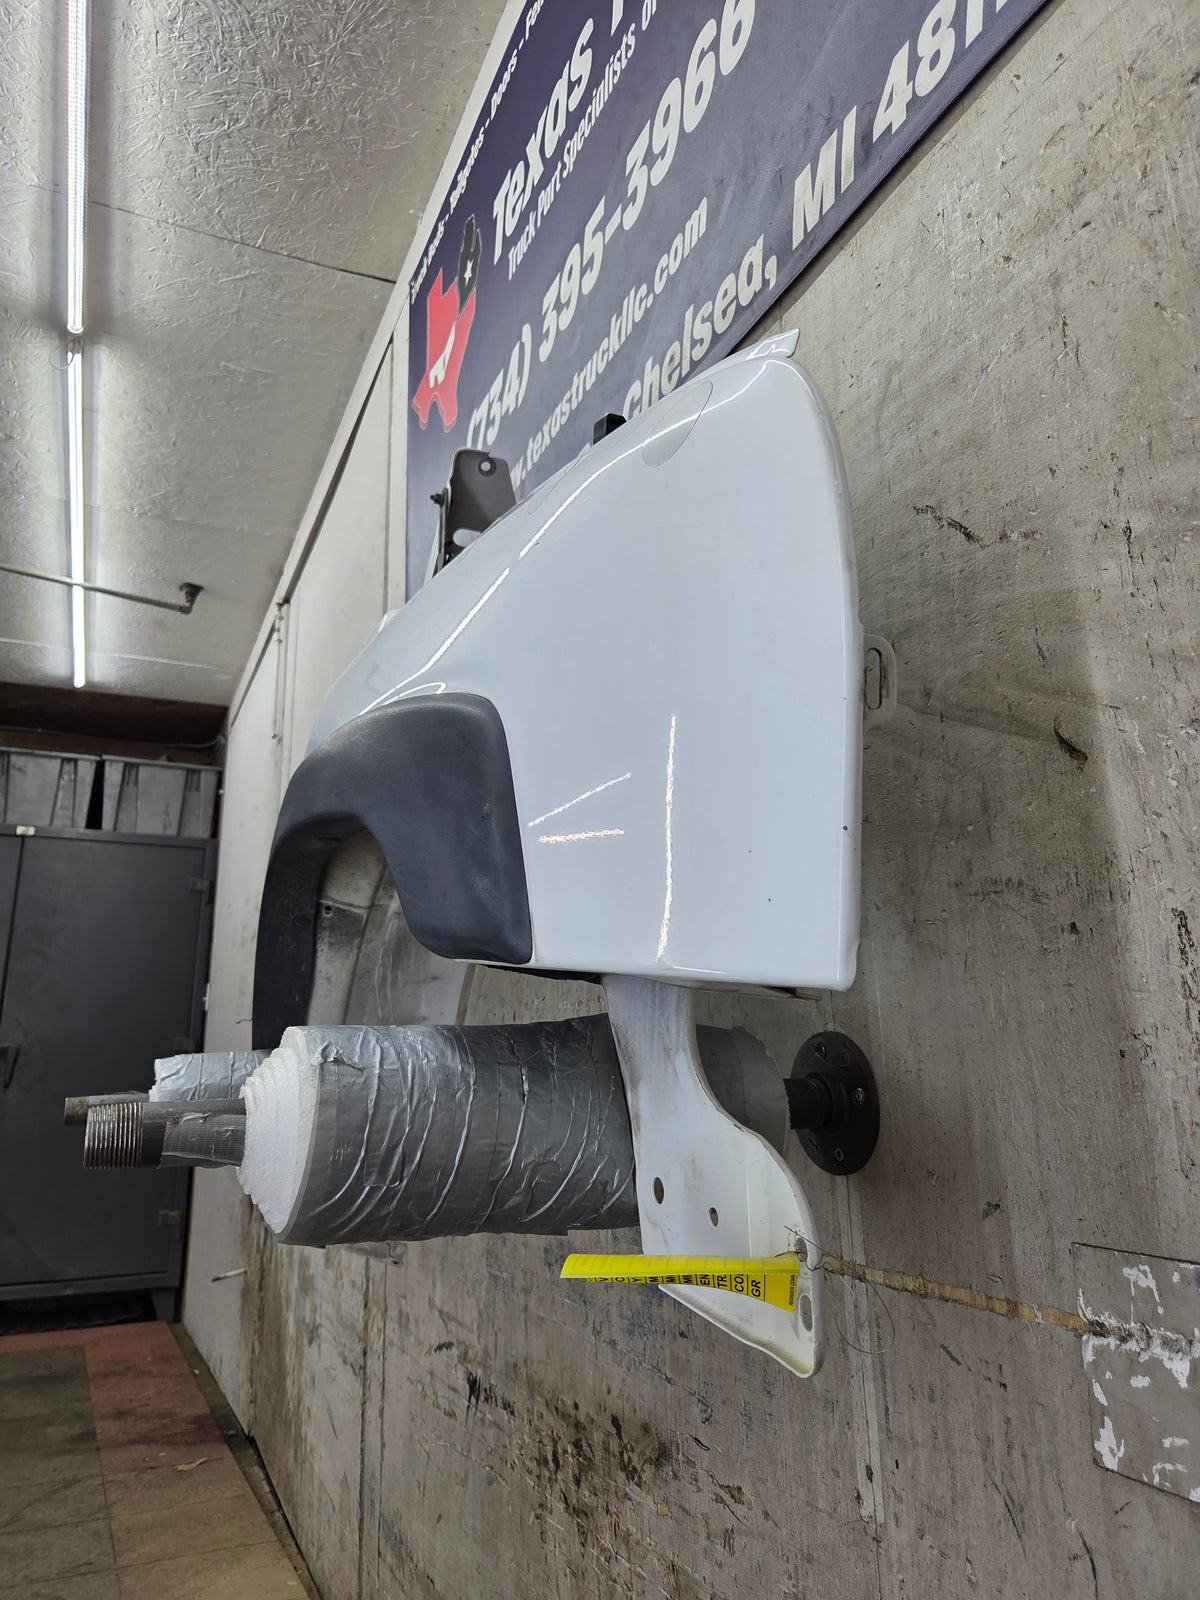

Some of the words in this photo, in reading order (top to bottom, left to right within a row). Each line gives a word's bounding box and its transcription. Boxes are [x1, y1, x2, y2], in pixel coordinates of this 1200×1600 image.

[491, 48, 518, 120] Doors
[492, 18, 594, 266] Texas
[508, 210, 536, 281] Truck
[536, 160, 562, 228] Part
[562, 22, 636, 179] Specialists
[622, 233, 778, 421] Chelsea,
[792, 104, 857, 250] MI
[872, 0, 1008, 143] 481
[466, 323, 532, 450] (734)
[538, 0, 756, 363] 395-3966
[751, 1280, 761, 1297] GR
